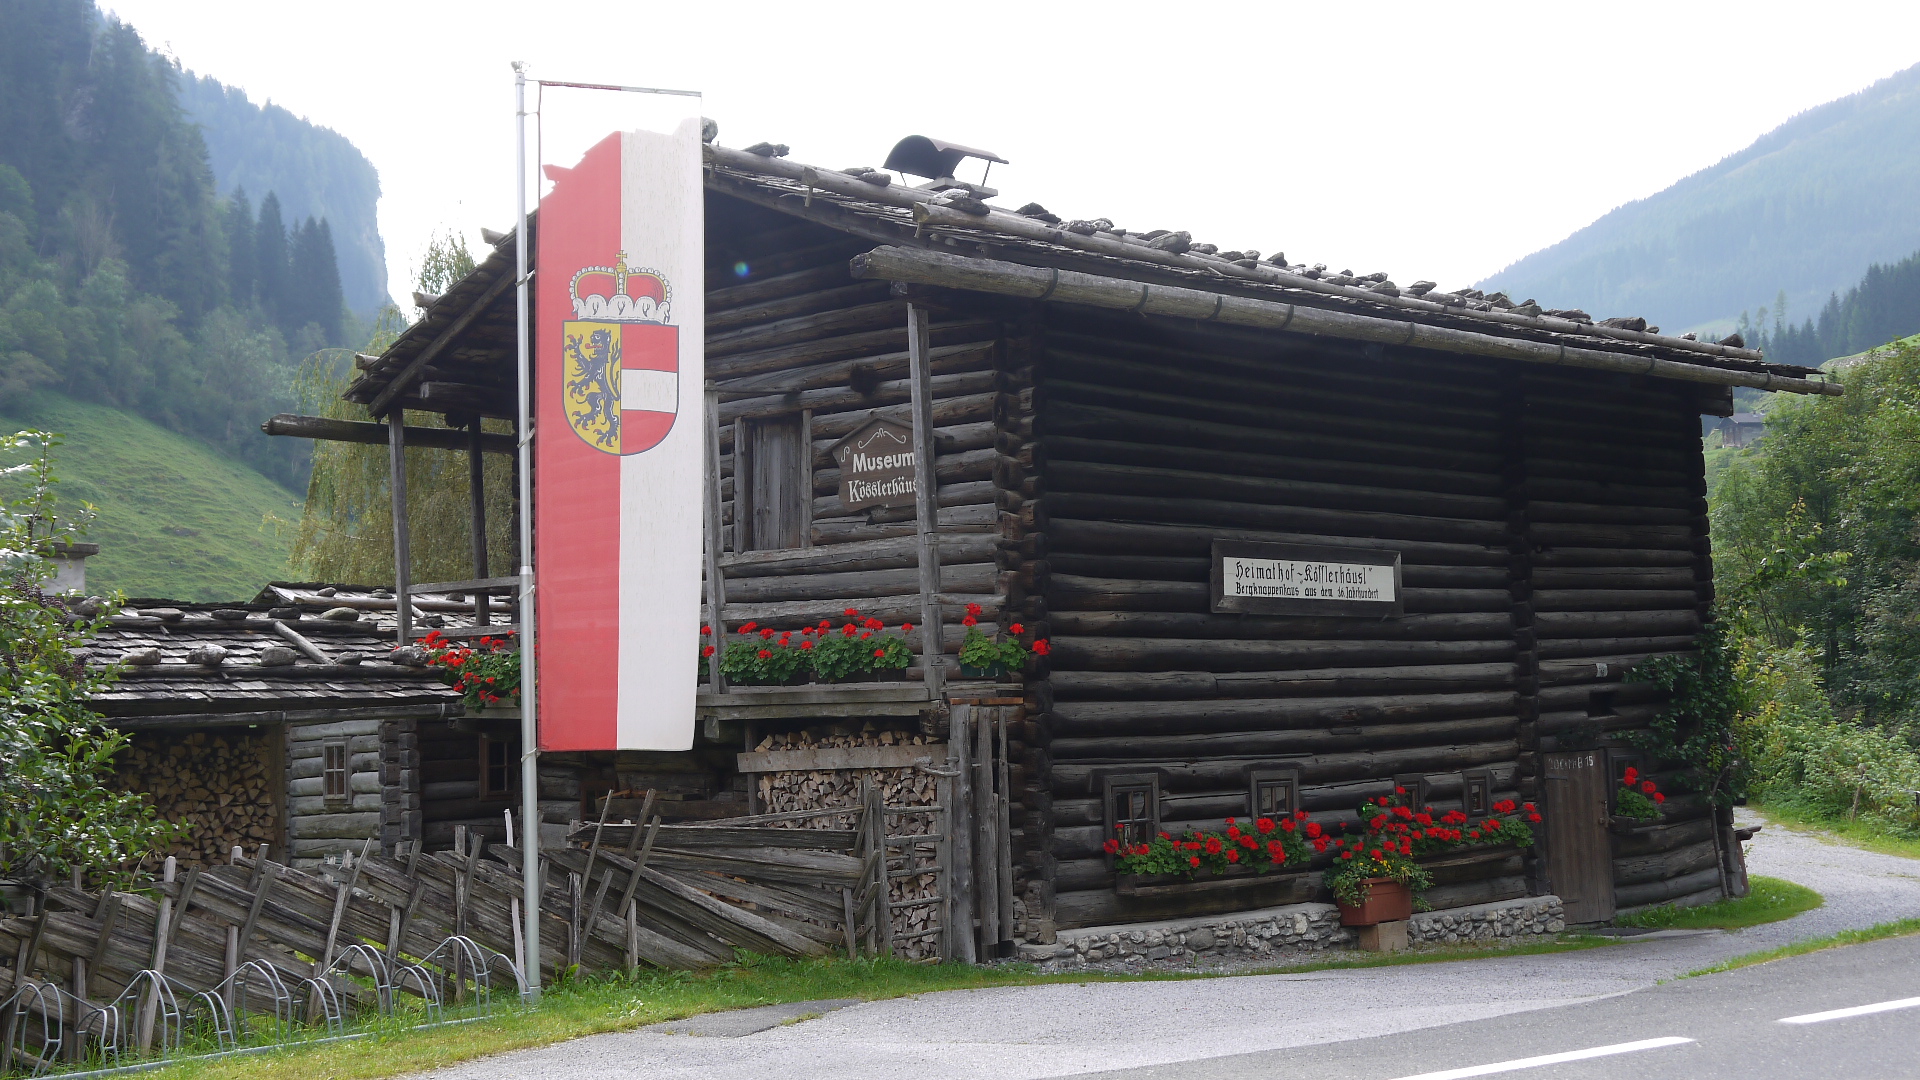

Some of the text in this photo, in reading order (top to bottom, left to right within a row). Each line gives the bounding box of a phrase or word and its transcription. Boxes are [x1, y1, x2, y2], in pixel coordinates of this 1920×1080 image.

[853, 452, 915, 473] Museum
[848, 476, 917, 502] Kösslerhäus
[1235, 582, 1300, 597] Bergknappenhaus
[1304, 587, 1317, 597] aus
[1320, 585, 1333, 598] dem
[1584, 755, 1594, 767] 15
